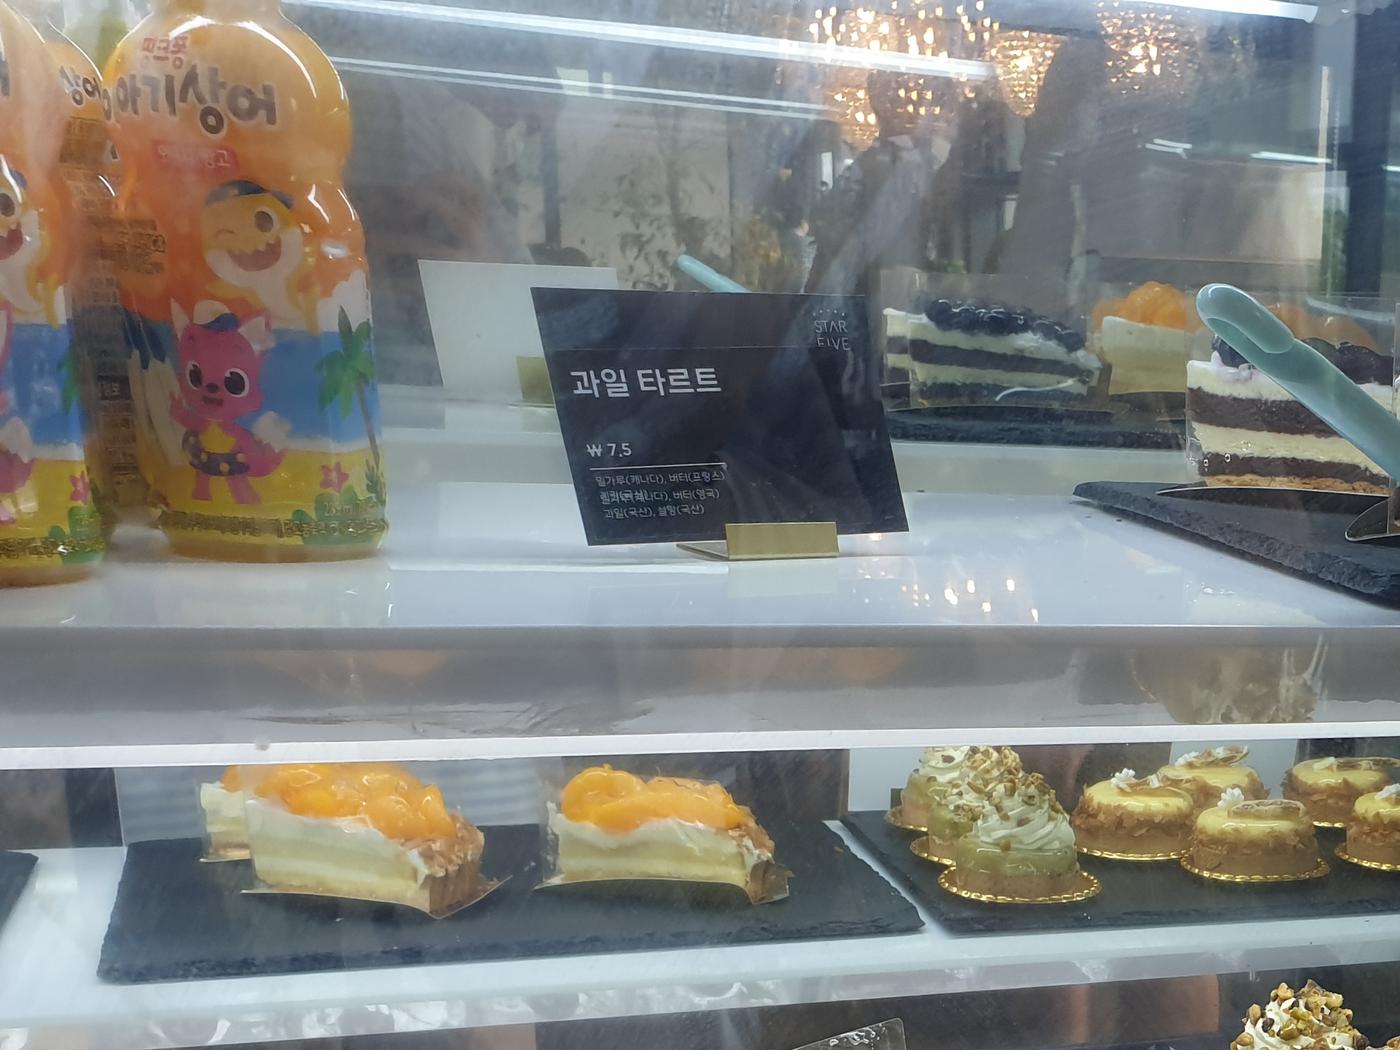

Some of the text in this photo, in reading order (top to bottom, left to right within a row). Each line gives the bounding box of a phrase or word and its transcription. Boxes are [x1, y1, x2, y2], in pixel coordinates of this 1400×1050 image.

[116, 64, 277, 135] 아기상어
[814, 320, 848, 333] STAR
[816, 337, 850, 351] FIVE
[570, 367, 722, 398] 과일 타르트
[607, 443, 632, 458] 7.5
